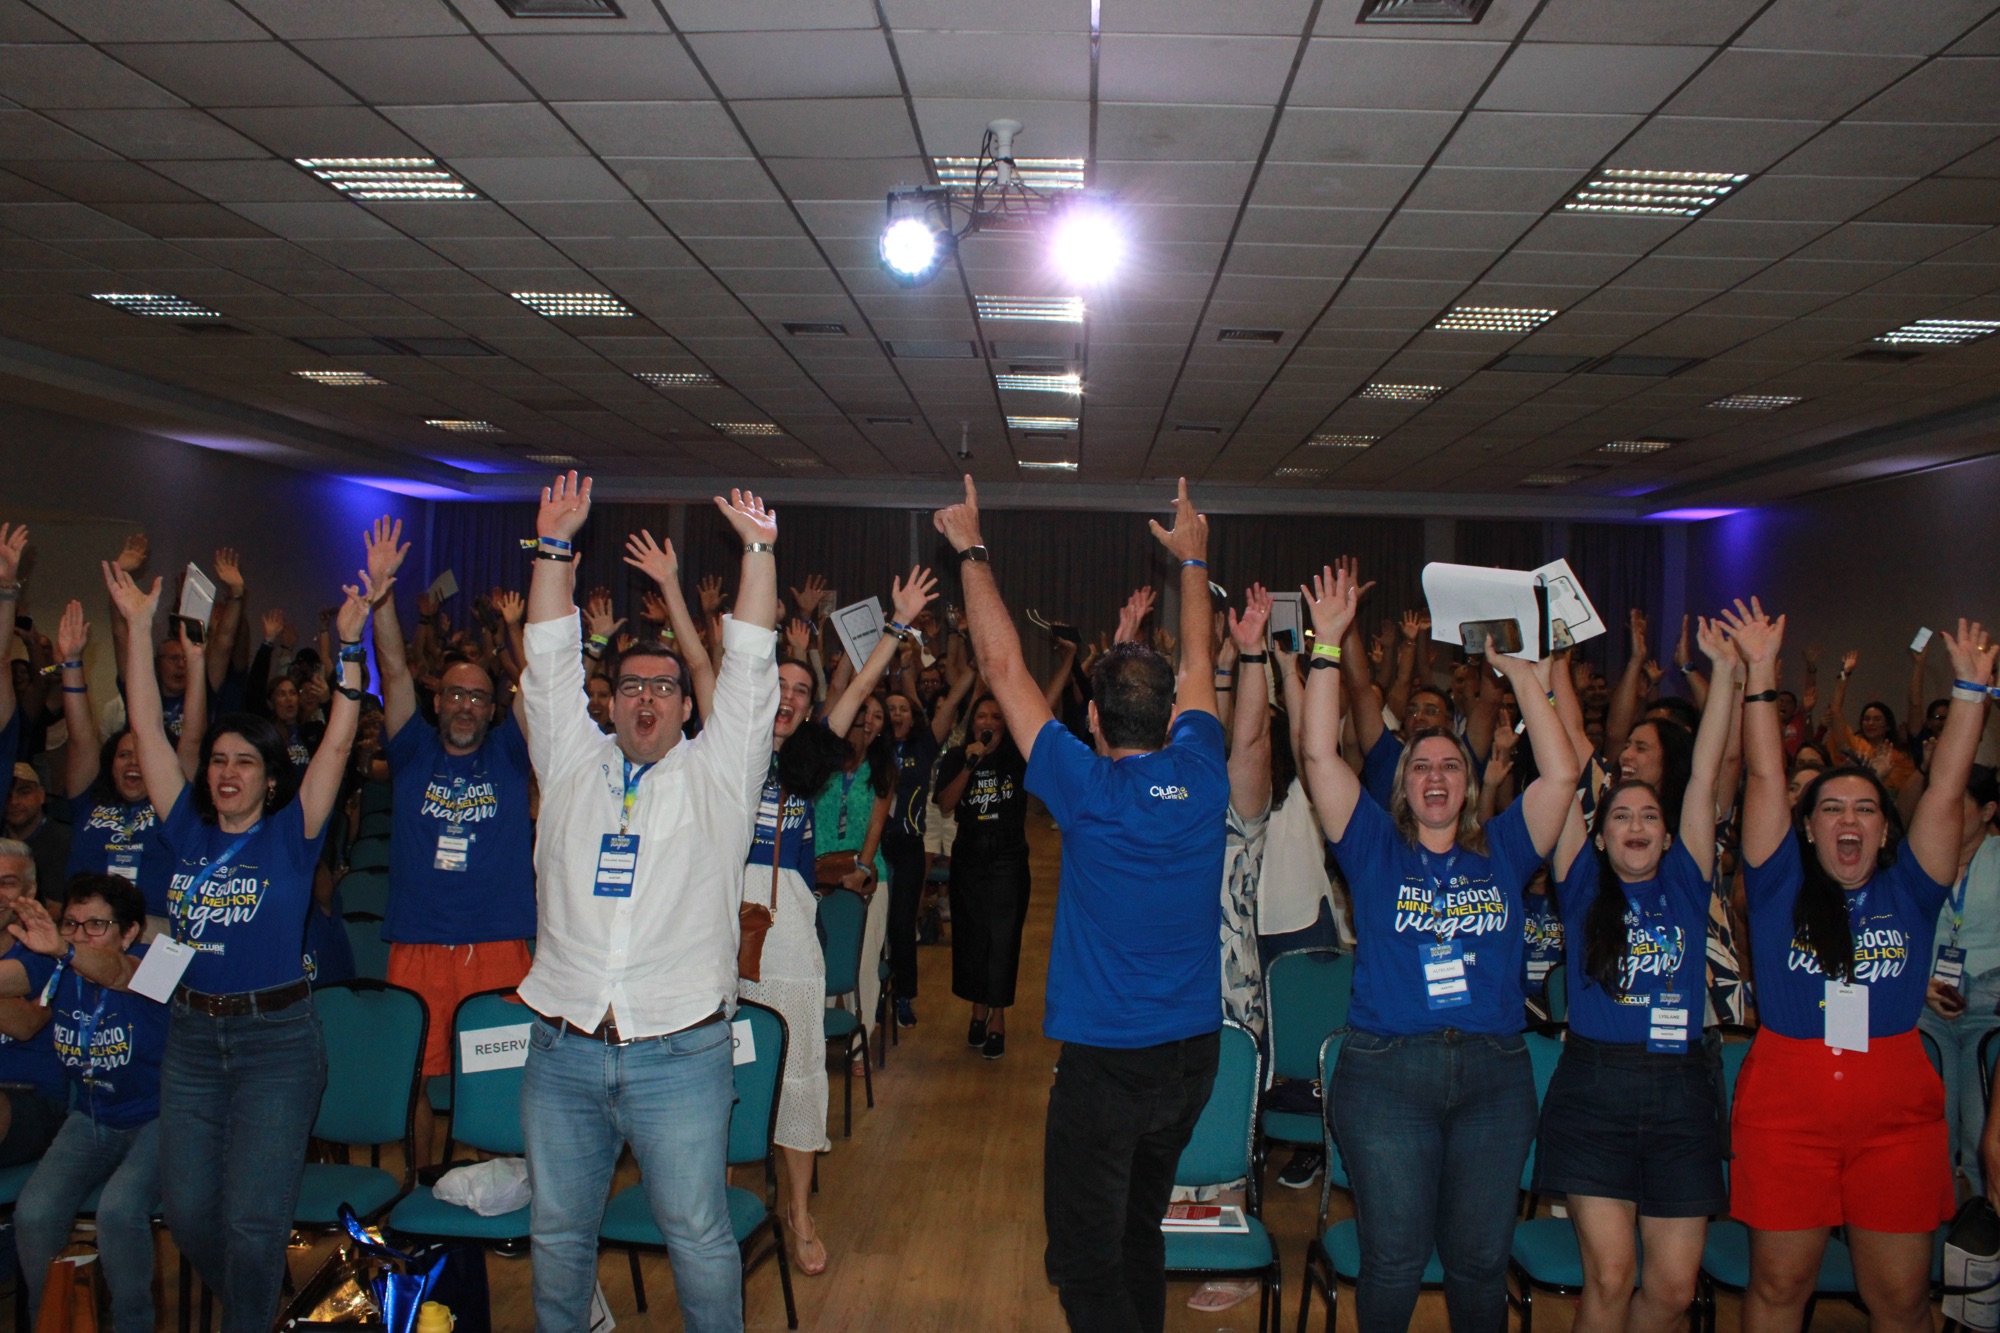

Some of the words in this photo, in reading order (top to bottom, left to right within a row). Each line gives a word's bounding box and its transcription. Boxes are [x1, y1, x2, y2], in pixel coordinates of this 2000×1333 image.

[427, 781, 451, 800] MEU
[105, 844, 143, 852] PROCUBE
[202, 894, 257, 907] MELHOR
[1398, 885, 1433, 903] MEU
[1443, 886, 1501, 908] EGÓCIO
[1397, 901, 1434, 914] MINH
[1447, 902, 1504, 917] MELHOR
[1395, 912, 1508, 942] viagem
[1855, 947, 1905, 961] ELHOR
[475, 1039, 527, 1055] RESERV
